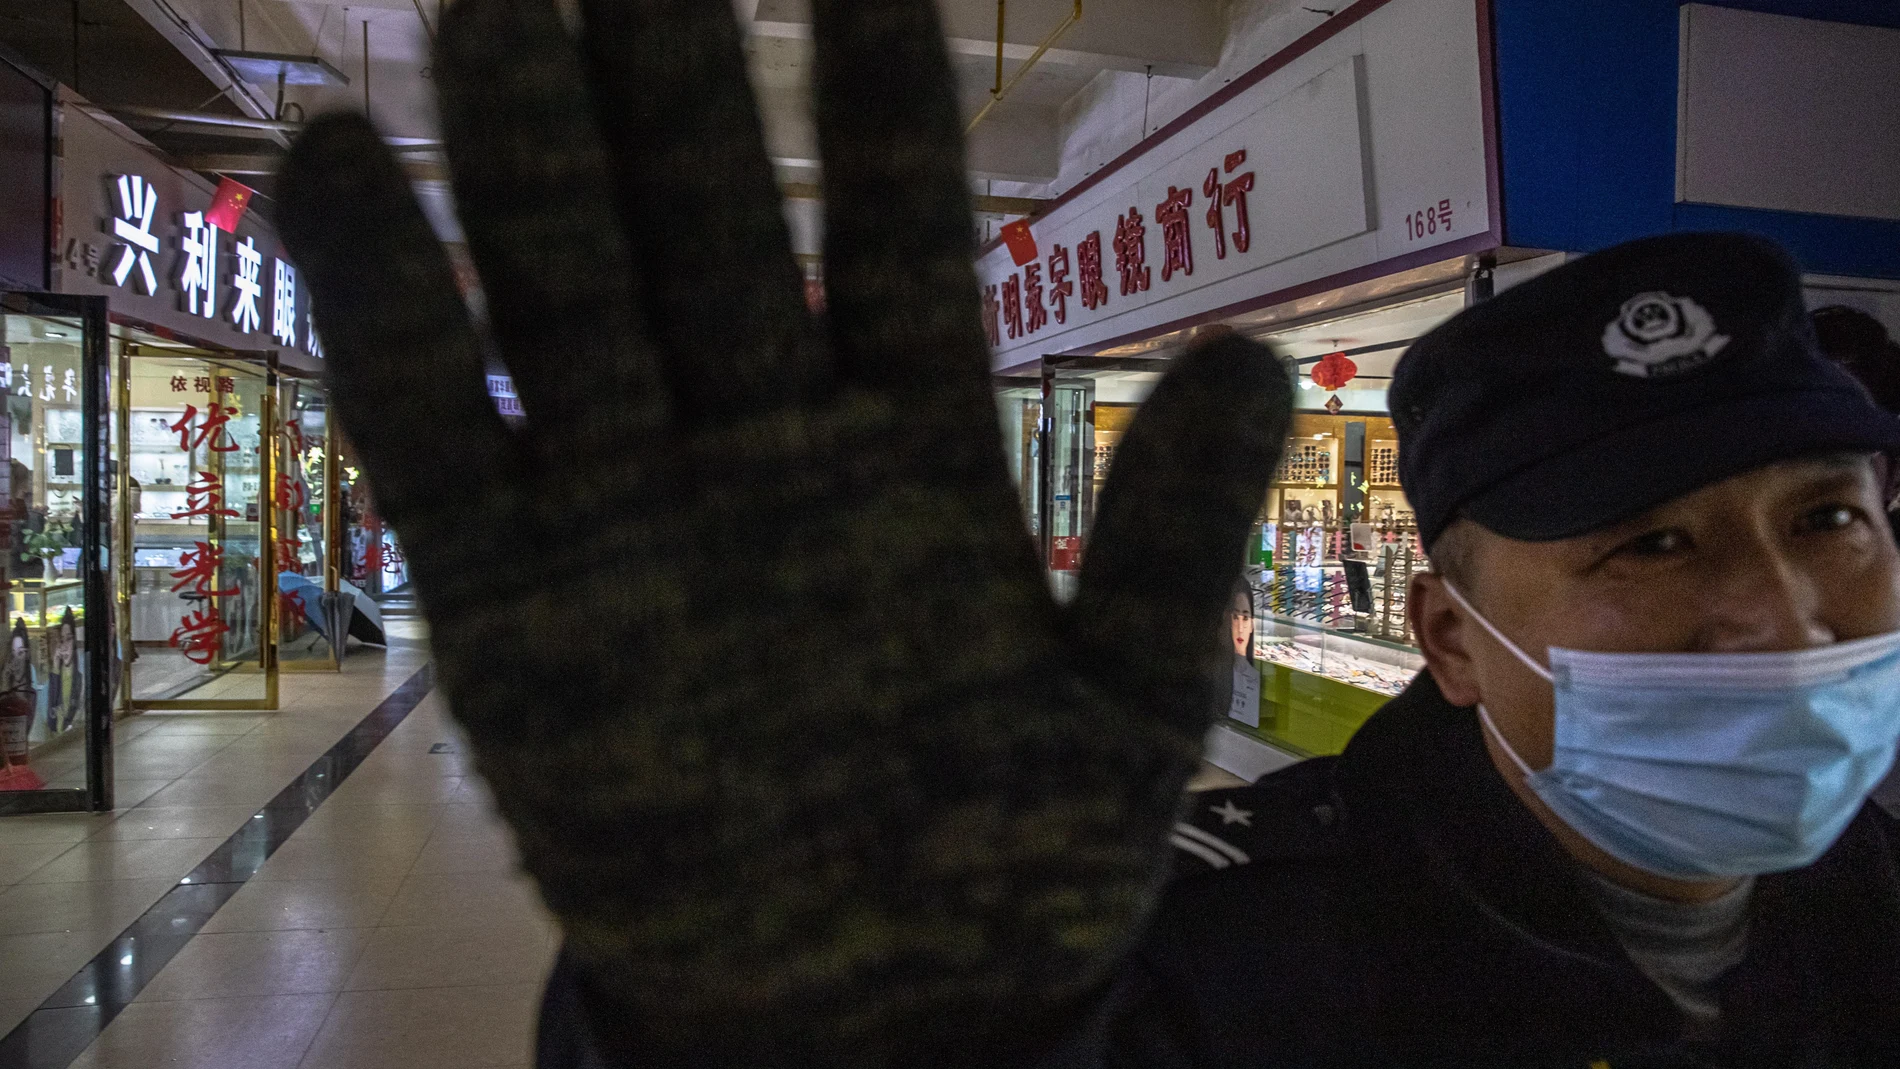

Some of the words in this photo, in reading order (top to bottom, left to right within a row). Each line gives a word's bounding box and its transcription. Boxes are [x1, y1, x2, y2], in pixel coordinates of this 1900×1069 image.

[112, 174, 325, 359] 兴利来眼
[1405, 198, 1453, 241] 168号
[170, 375, 234, 393] 依视路
[169, 403, 241, 664] 优立光学
